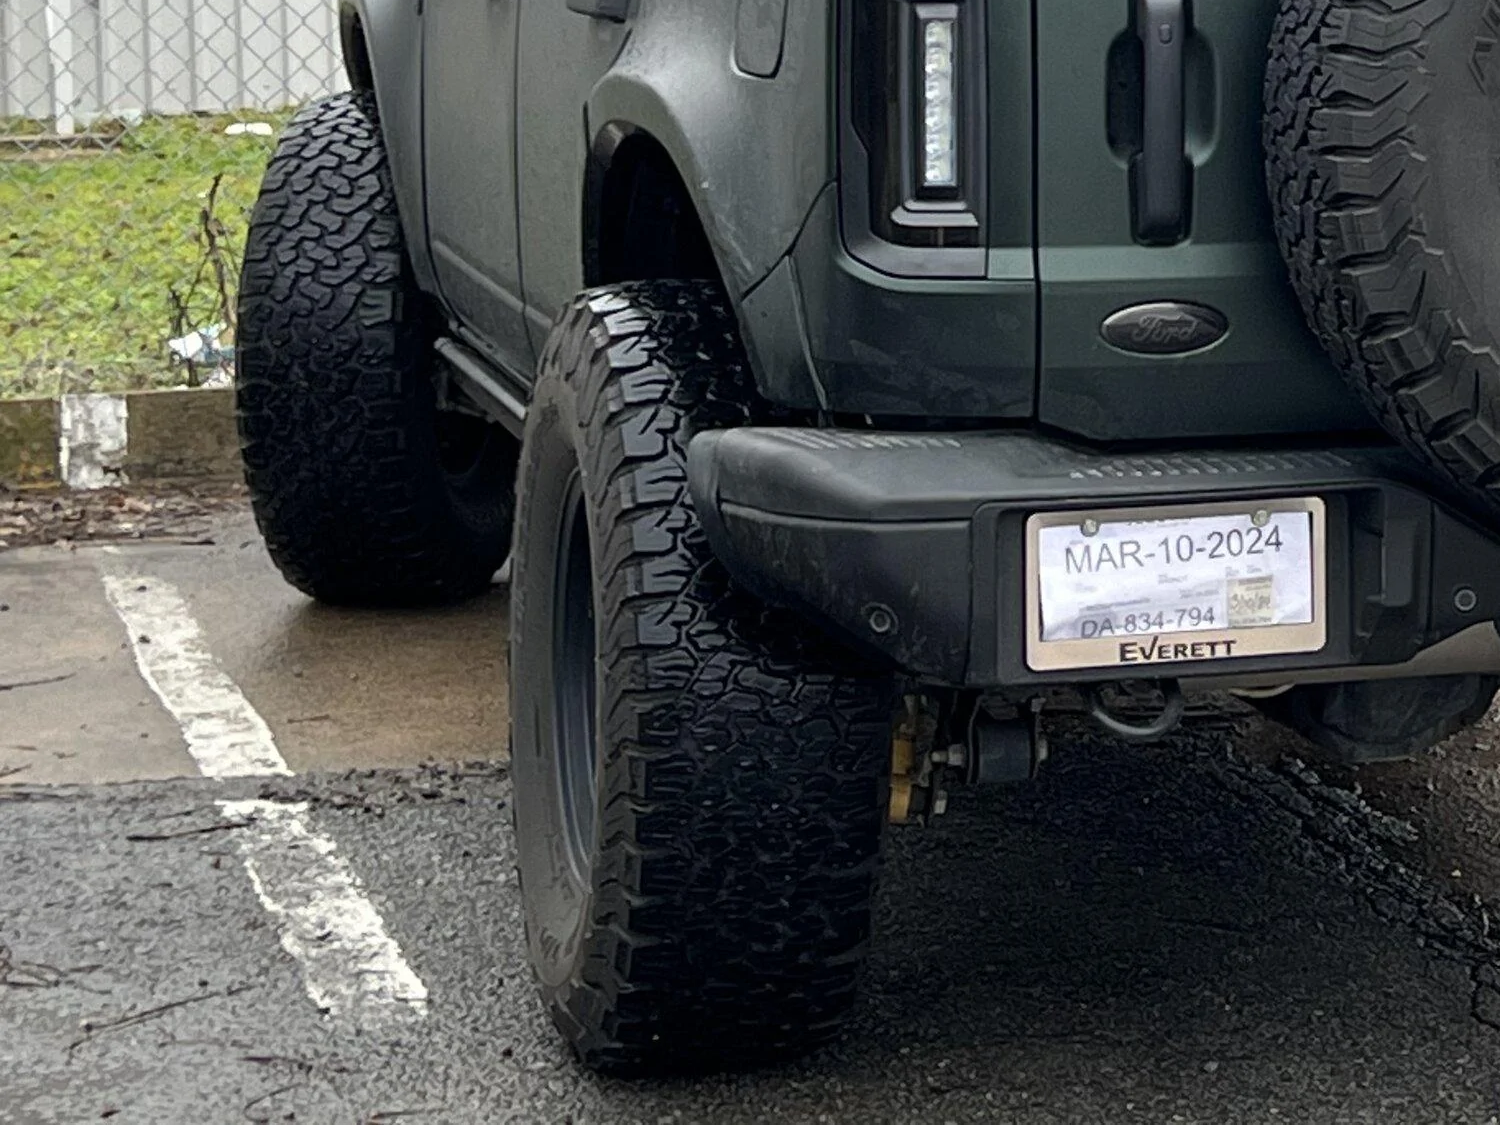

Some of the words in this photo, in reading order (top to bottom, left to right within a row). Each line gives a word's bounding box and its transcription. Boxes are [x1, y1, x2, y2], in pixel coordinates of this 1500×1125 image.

[1131, 311, 1199, 344] Ford
[1064, 524, 1283, 575] MAR-10-2024
[1080, 605, 1216, 640] DA-834-794
[1119, 635, 1237, 663] EVERETT
